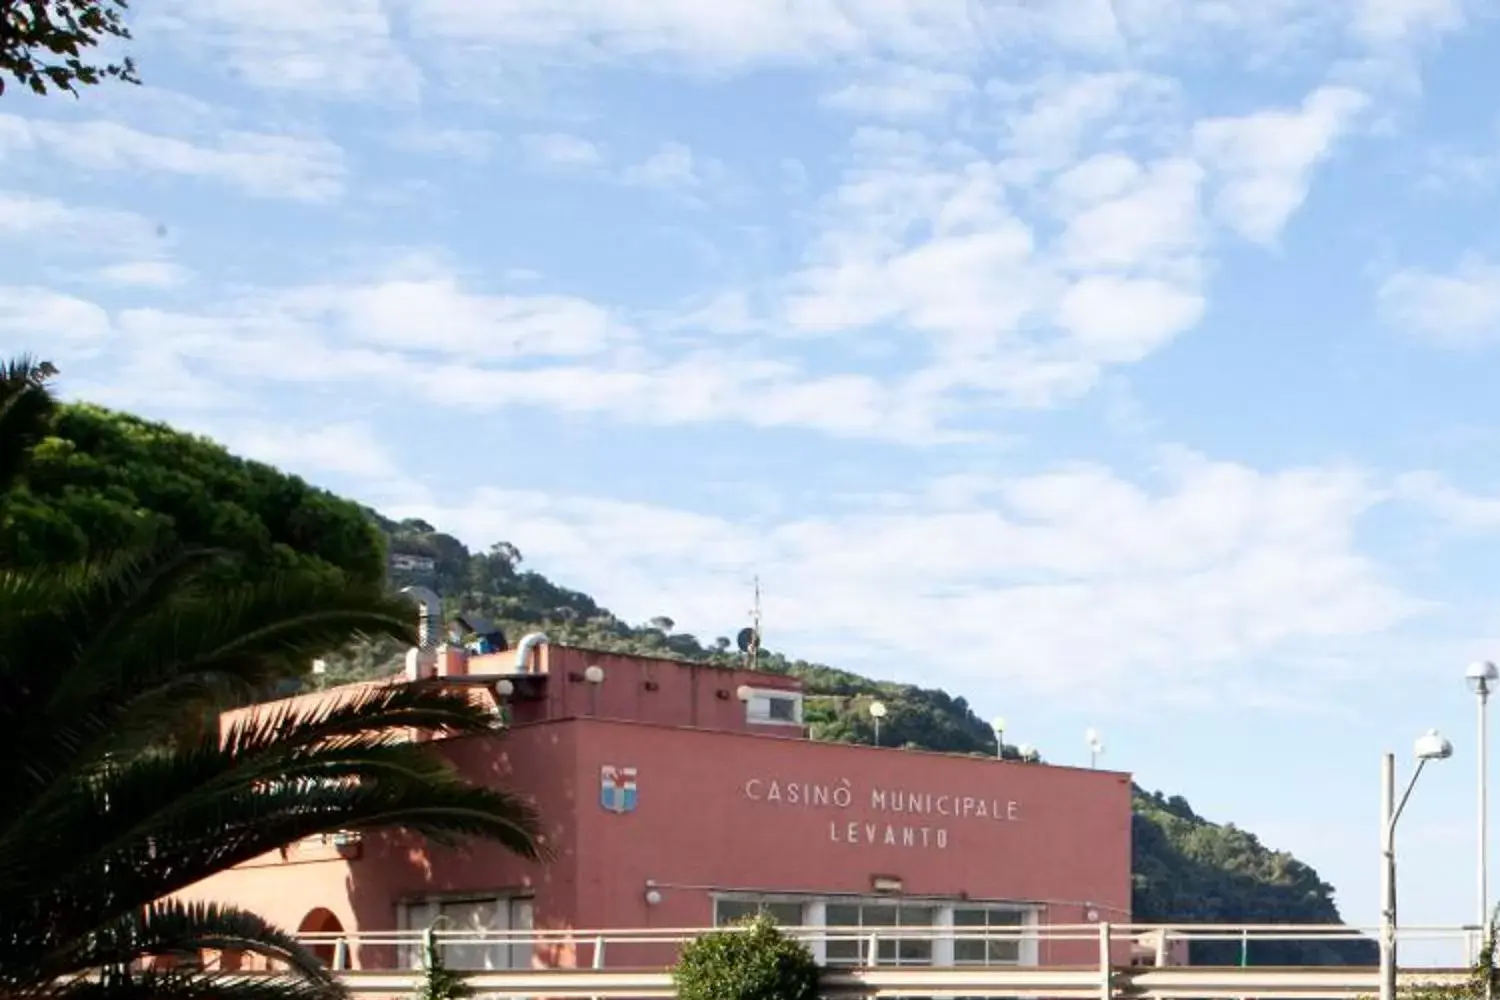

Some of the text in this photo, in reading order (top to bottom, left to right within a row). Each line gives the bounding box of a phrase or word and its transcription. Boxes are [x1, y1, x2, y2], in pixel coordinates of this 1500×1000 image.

[745, 777, 1020, 821] CASINÒ MUNICIPALE
[830, 821, 948, 849] LEVANTO
